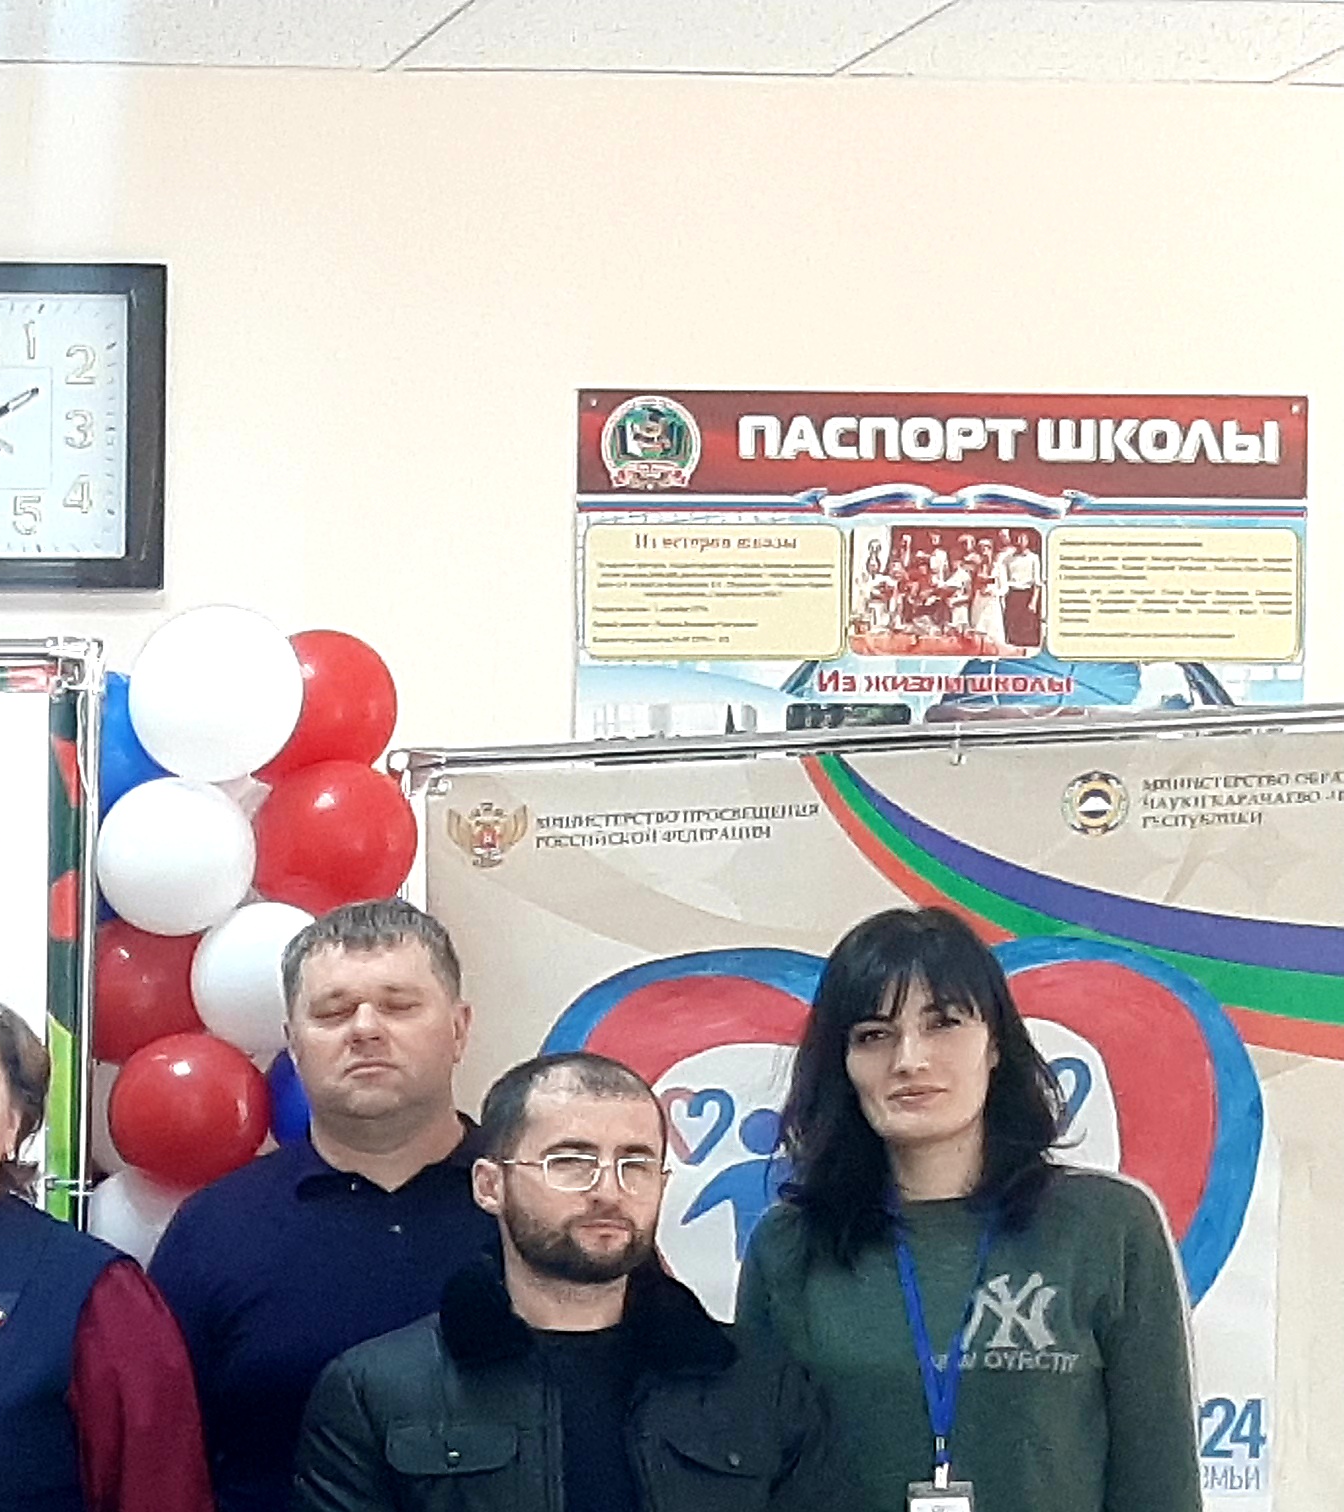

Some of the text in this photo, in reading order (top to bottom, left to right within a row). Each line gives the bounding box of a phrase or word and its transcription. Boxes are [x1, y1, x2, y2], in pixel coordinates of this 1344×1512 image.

[24, 320, 36, 360] 1
[65, 344, 97, 386] 2
[64, 409, 95, 450] 3
[737, 414, 1281, 466] ПАСПОРТ ШКОЛЫ
[63, 474, 94, 515] 4
[12, 495, 42, 536] 5
[817, 669, 858, 693] Из
[968, 674, 1075, 694] школы
[961, 1273, 1058, 1351] NY
[1198, 1397, 1267, 1459] 24
